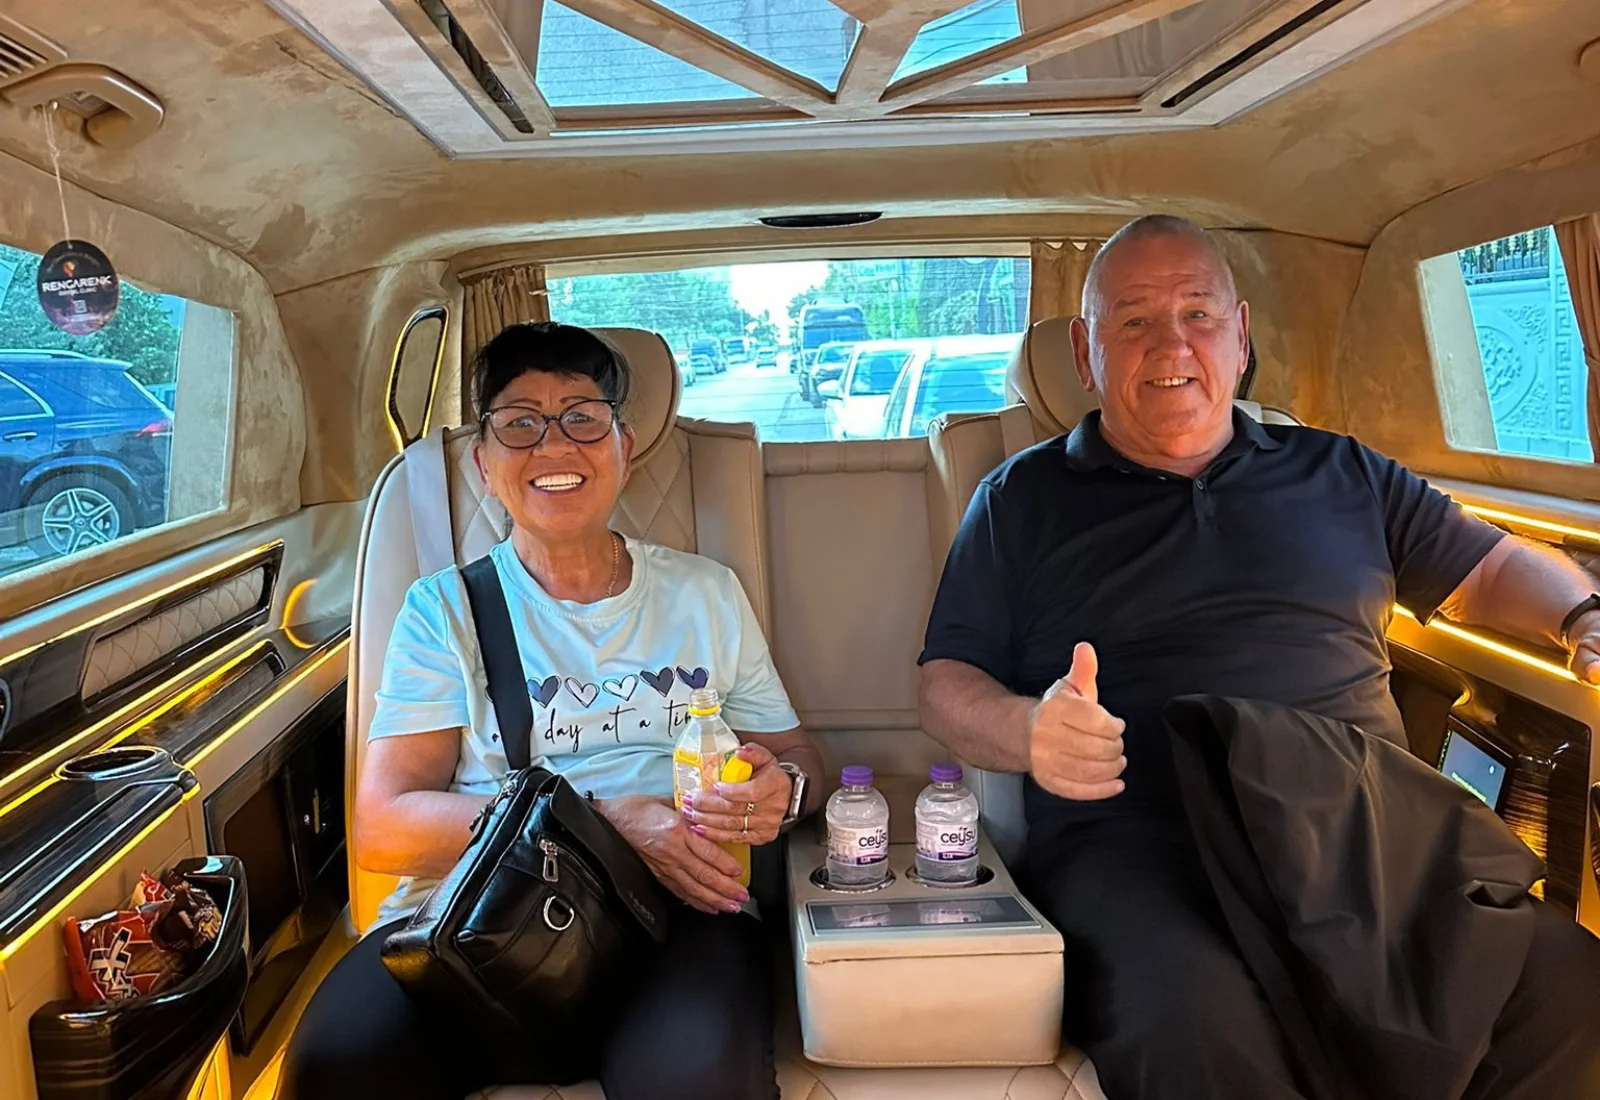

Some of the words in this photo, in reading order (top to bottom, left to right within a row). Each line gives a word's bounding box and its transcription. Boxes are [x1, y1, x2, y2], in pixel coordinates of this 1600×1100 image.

[544, 708, 583, 753] day
[602, 705, 636, 743] at
[639, 719, 652, 728] a
